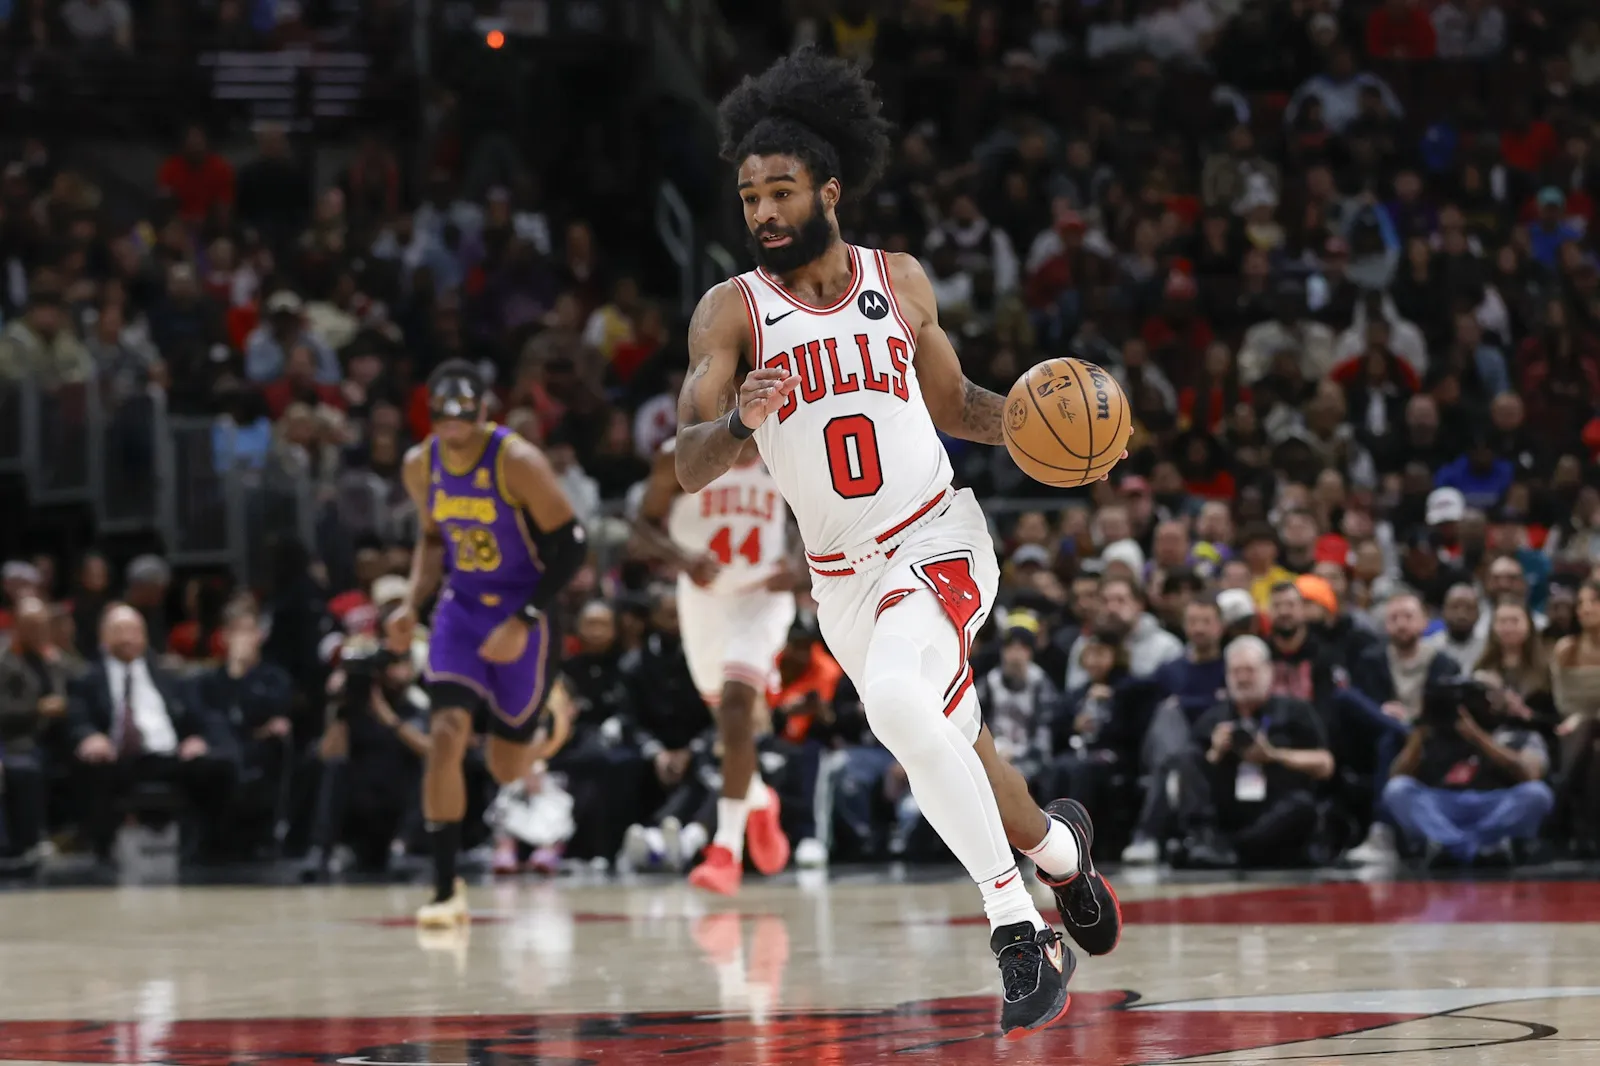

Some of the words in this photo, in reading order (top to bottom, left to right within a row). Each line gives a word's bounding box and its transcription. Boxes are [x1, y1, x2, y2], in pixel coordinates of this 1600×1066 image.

[764, 333, 910, 425] BULLS
[822, 413, 884, 500] 0
[708, 526, 762, 566] 44
